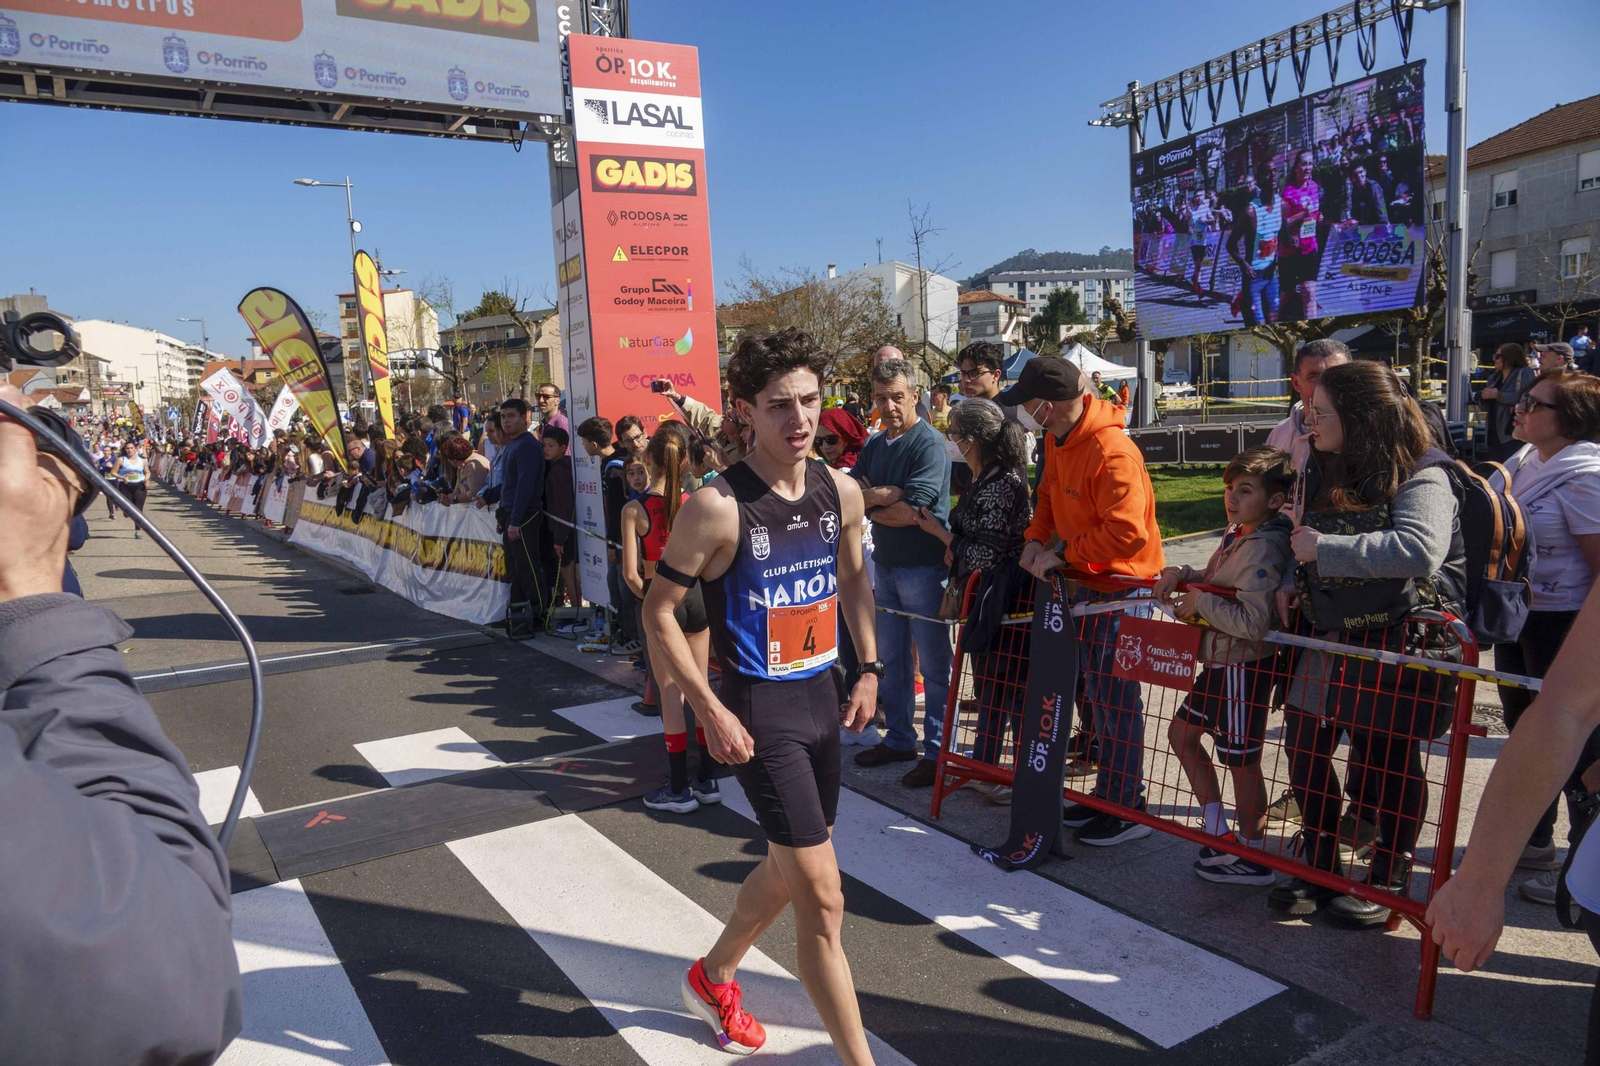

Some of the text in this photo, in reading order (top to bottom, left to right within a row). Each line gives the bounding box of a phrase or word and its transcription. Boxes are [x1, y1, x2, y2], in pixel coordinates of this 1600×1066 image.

[48, 35, 110, 54] Porriño
[213, 53, 268, 71] Porriño
[359, 69, 407, 85] Porriño
[487, 82, 530, 98] Porriño
[611, 100, 694, 131] LASAL
[665, 130, 695, 139] cocinas
[595, 158, 694, 192] GADIS
[620, 210, 671, 221] RODOSA
[630, 245, 689, 256] ELECPOR
[1343, 240, 1416, 265] RODOSA
[620, 285, 650, 295] Grupo
[1347, 282, 1393, 296] ALPINE
[613, 296, 686, 306] Godoy Maceira
[619, 336, 676, 349] NaturGas
[786, 520, 809, 531] amura
[763, 555, 834, 578] CLUB ATLETISMO
[1343, 612, 1389, 630] Harry Potter
[802, 625, 816, 655] 4
